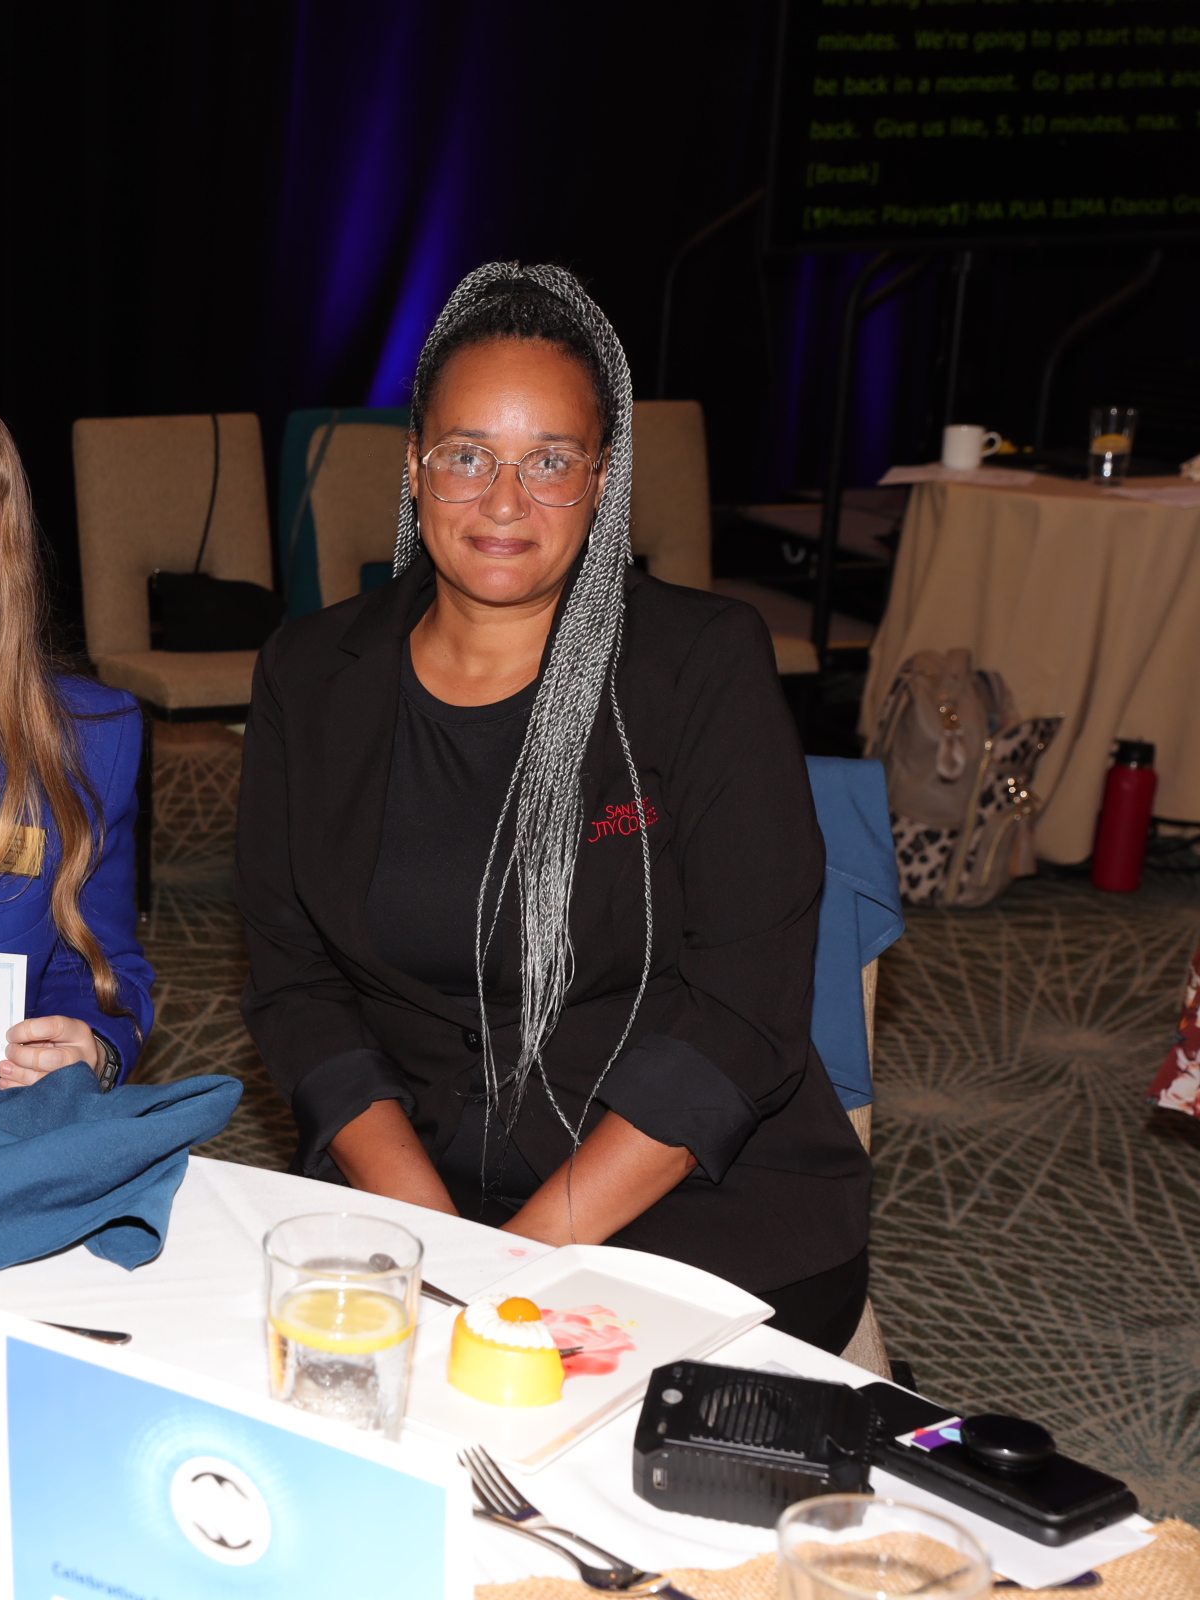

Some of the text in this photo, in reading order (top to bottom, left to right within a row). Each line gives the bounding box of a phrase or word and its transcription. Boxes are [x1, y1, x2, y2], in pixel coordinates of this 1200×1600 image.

[816, 30, 901, 51] minutes.
[915, 29, 969, 49] We're
[973, 29, 1027, 53] going
[1031, 28, 1052, 47] to
[1056, 29, 1081, 51] go
[1085, 27, 1130, 46] start
[1134, 25, 1165, 45] the
[813, 75, 839, 96] be
[843, 75, 889, 96] back
[894, 74, 913, 94] in
[917, 76, 931, 94] a
[935, 72, 1020, 94] moment.
[1032, 69, 1060, 91] Go
[1064, 70, 1094, 94] get
[1099, 72, 1113, 90] a
[1117, 68, 1165, 89] drink
[810, 118, 860, 140] back.
[873, 117, 917, 138] Give
[922, 120, 945, 137] us
[950, 115, 989, 139] like,
[1021, 113, 1045, 135] 10
[1049, 113, 1130, 134] minutes,
[1135, 113, 1182, 131] max.
[806, 162, 879, 187] [Break]
[1008, 198, 1047, 219] PUA
[1111, 195, 1169, 215] Dance
